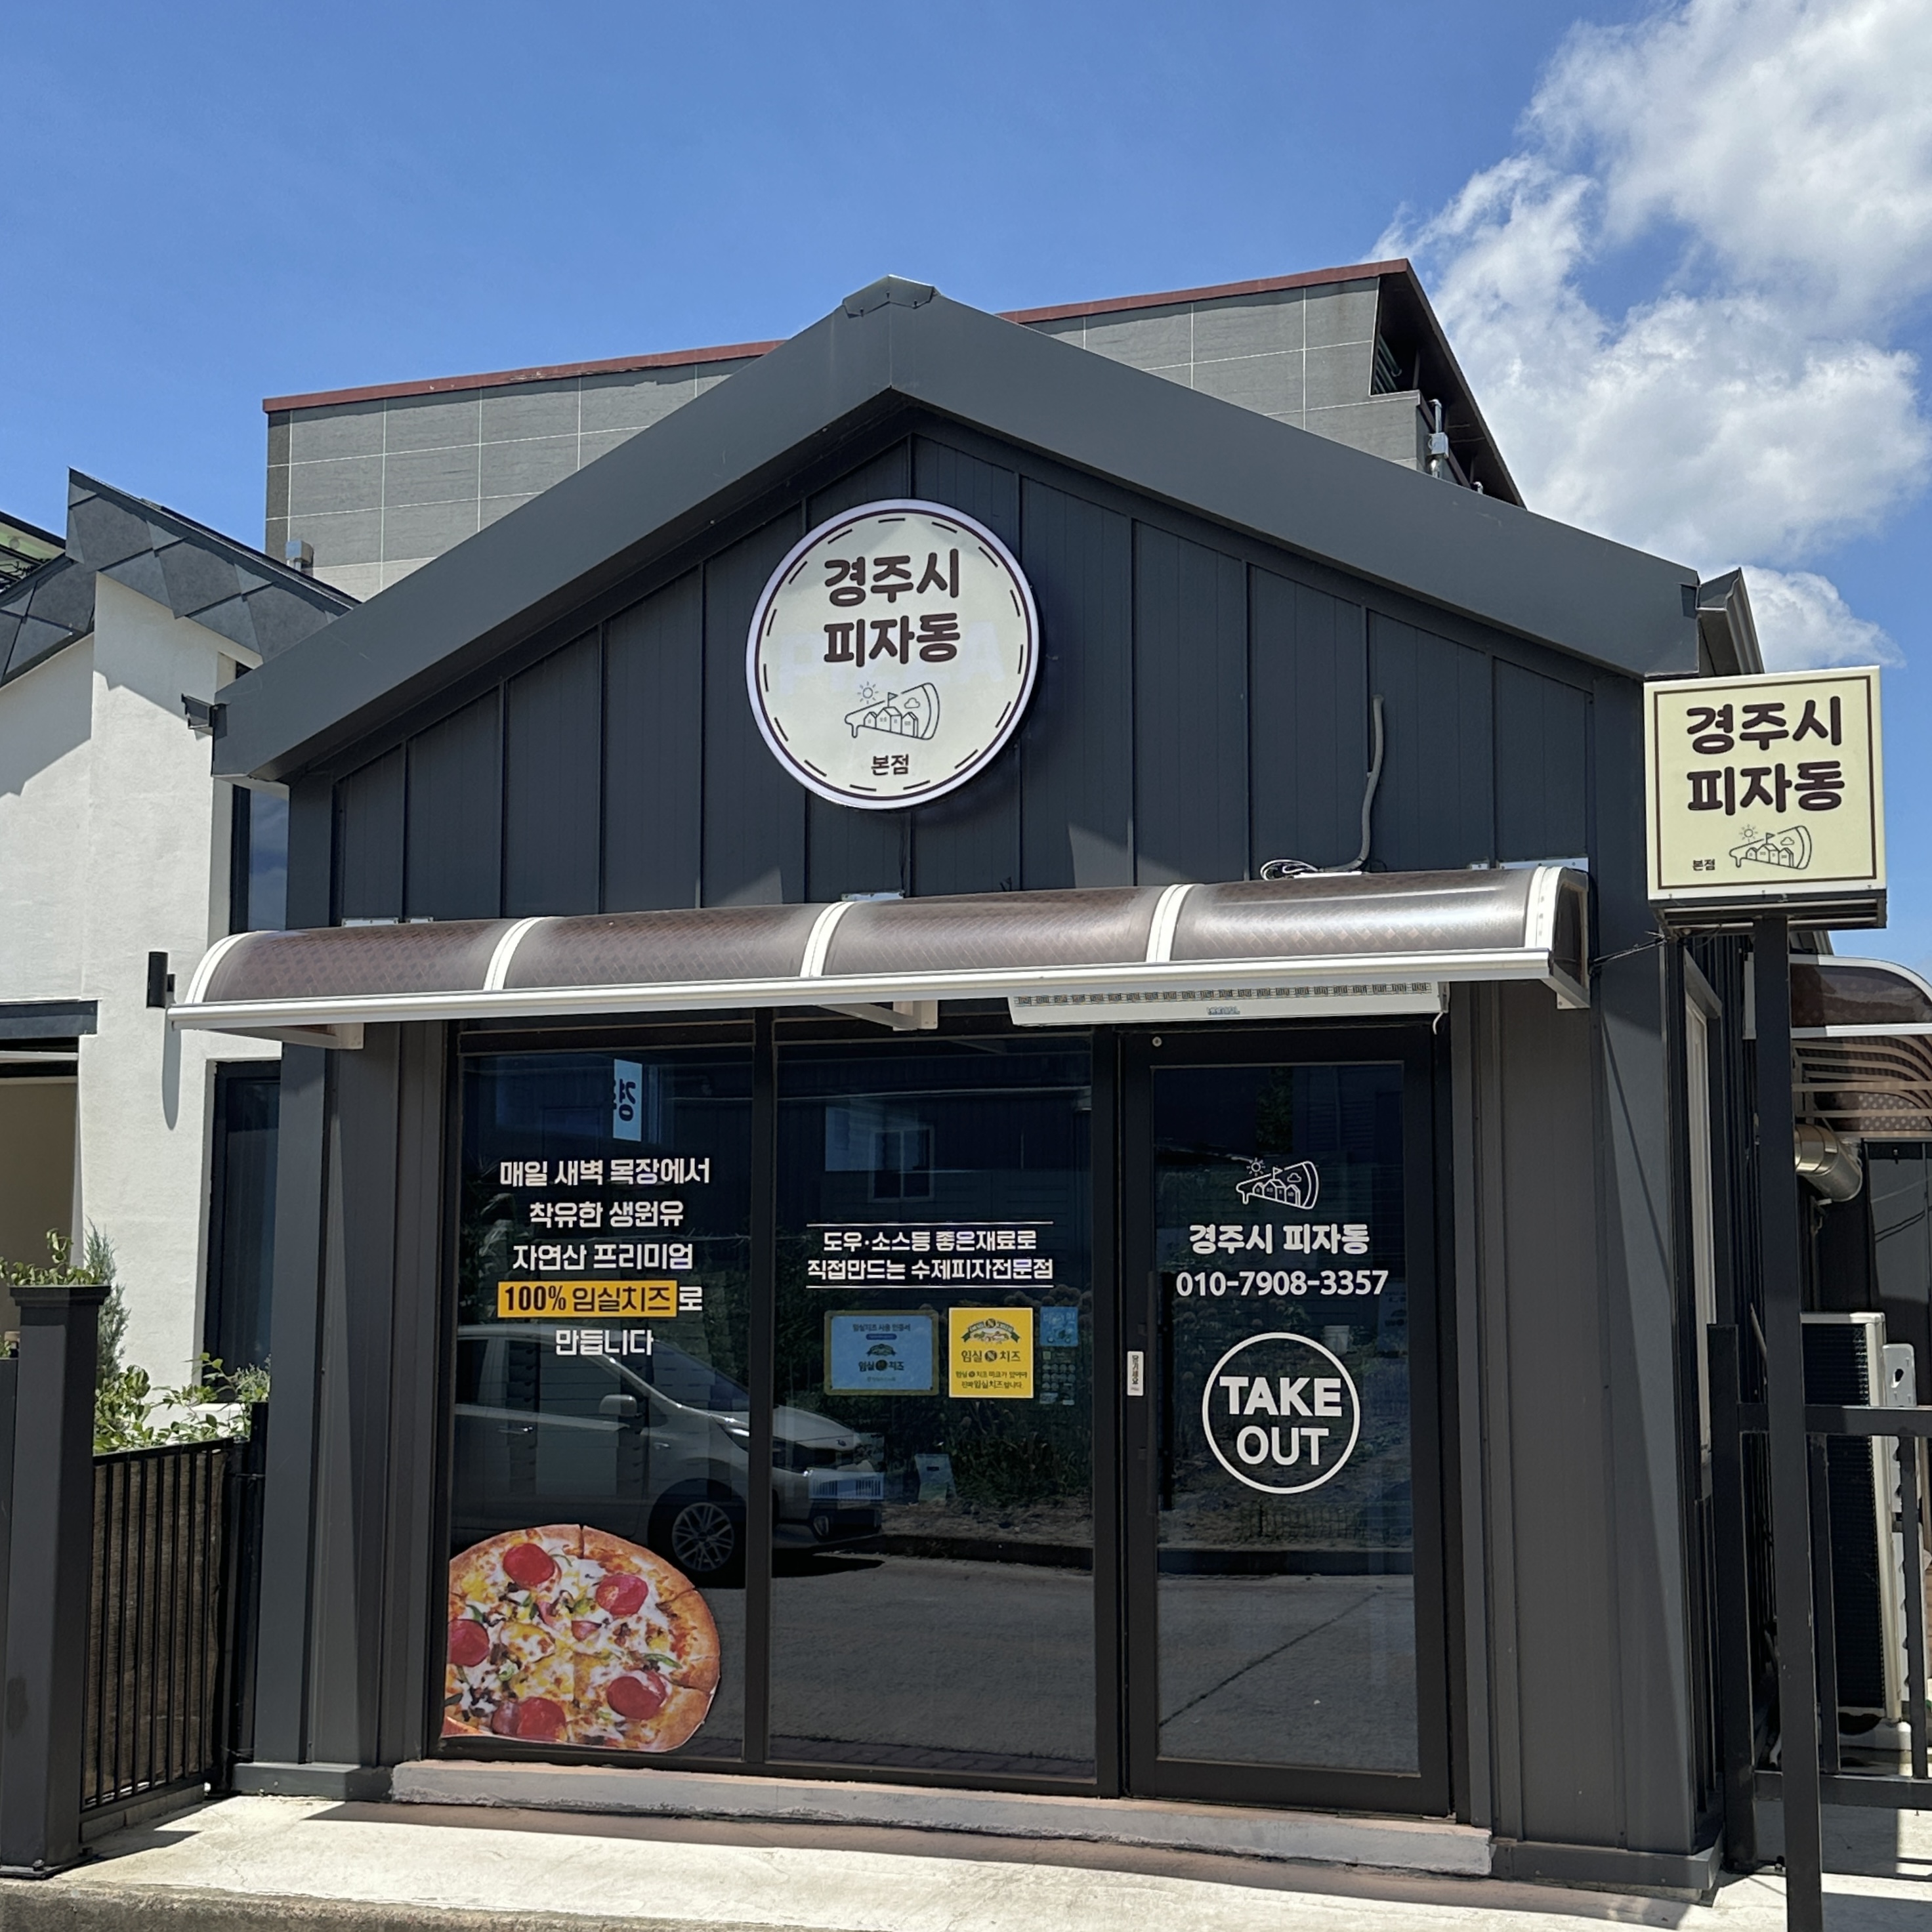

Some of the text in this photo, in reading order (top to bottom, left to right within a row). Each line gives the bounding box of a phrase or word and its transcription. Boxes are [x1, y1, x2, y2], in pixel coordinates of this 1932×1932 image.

[824, 548, 959, 608] 경주시
[823, 612, 961, 668] 피자동
[1686, 696, 1842, 755] 경주시
[871, 753, 909, 776] 본점
[1686, 760, 1845, 816] 피자동
[1692, 858, 1715, 872] 본점
[499, 1158, 710, 1187] 매일 새벽 목장에서
[530, 1200, 684, 1228] 착유한 생원유
[936, 1230, 1036, 1251] 좋은재료로
[1189, 1223, 1370, 1255] 경주시 피자동
[513, 1243, 693, 1271] 자연산 프리미엄
[807, 1259, 1053, 1280] 직접만드는 수제피자전문점
[1176, 1270, 1389, 1297] 010-7908-3357
[505, 1285, 567, 1312] 100%
[555, 1329, 654, 1356] 만듭니다
[1219, 1376, 1342, 1418] TAKE
[1236, 1425, 1330, 1466] OUT
